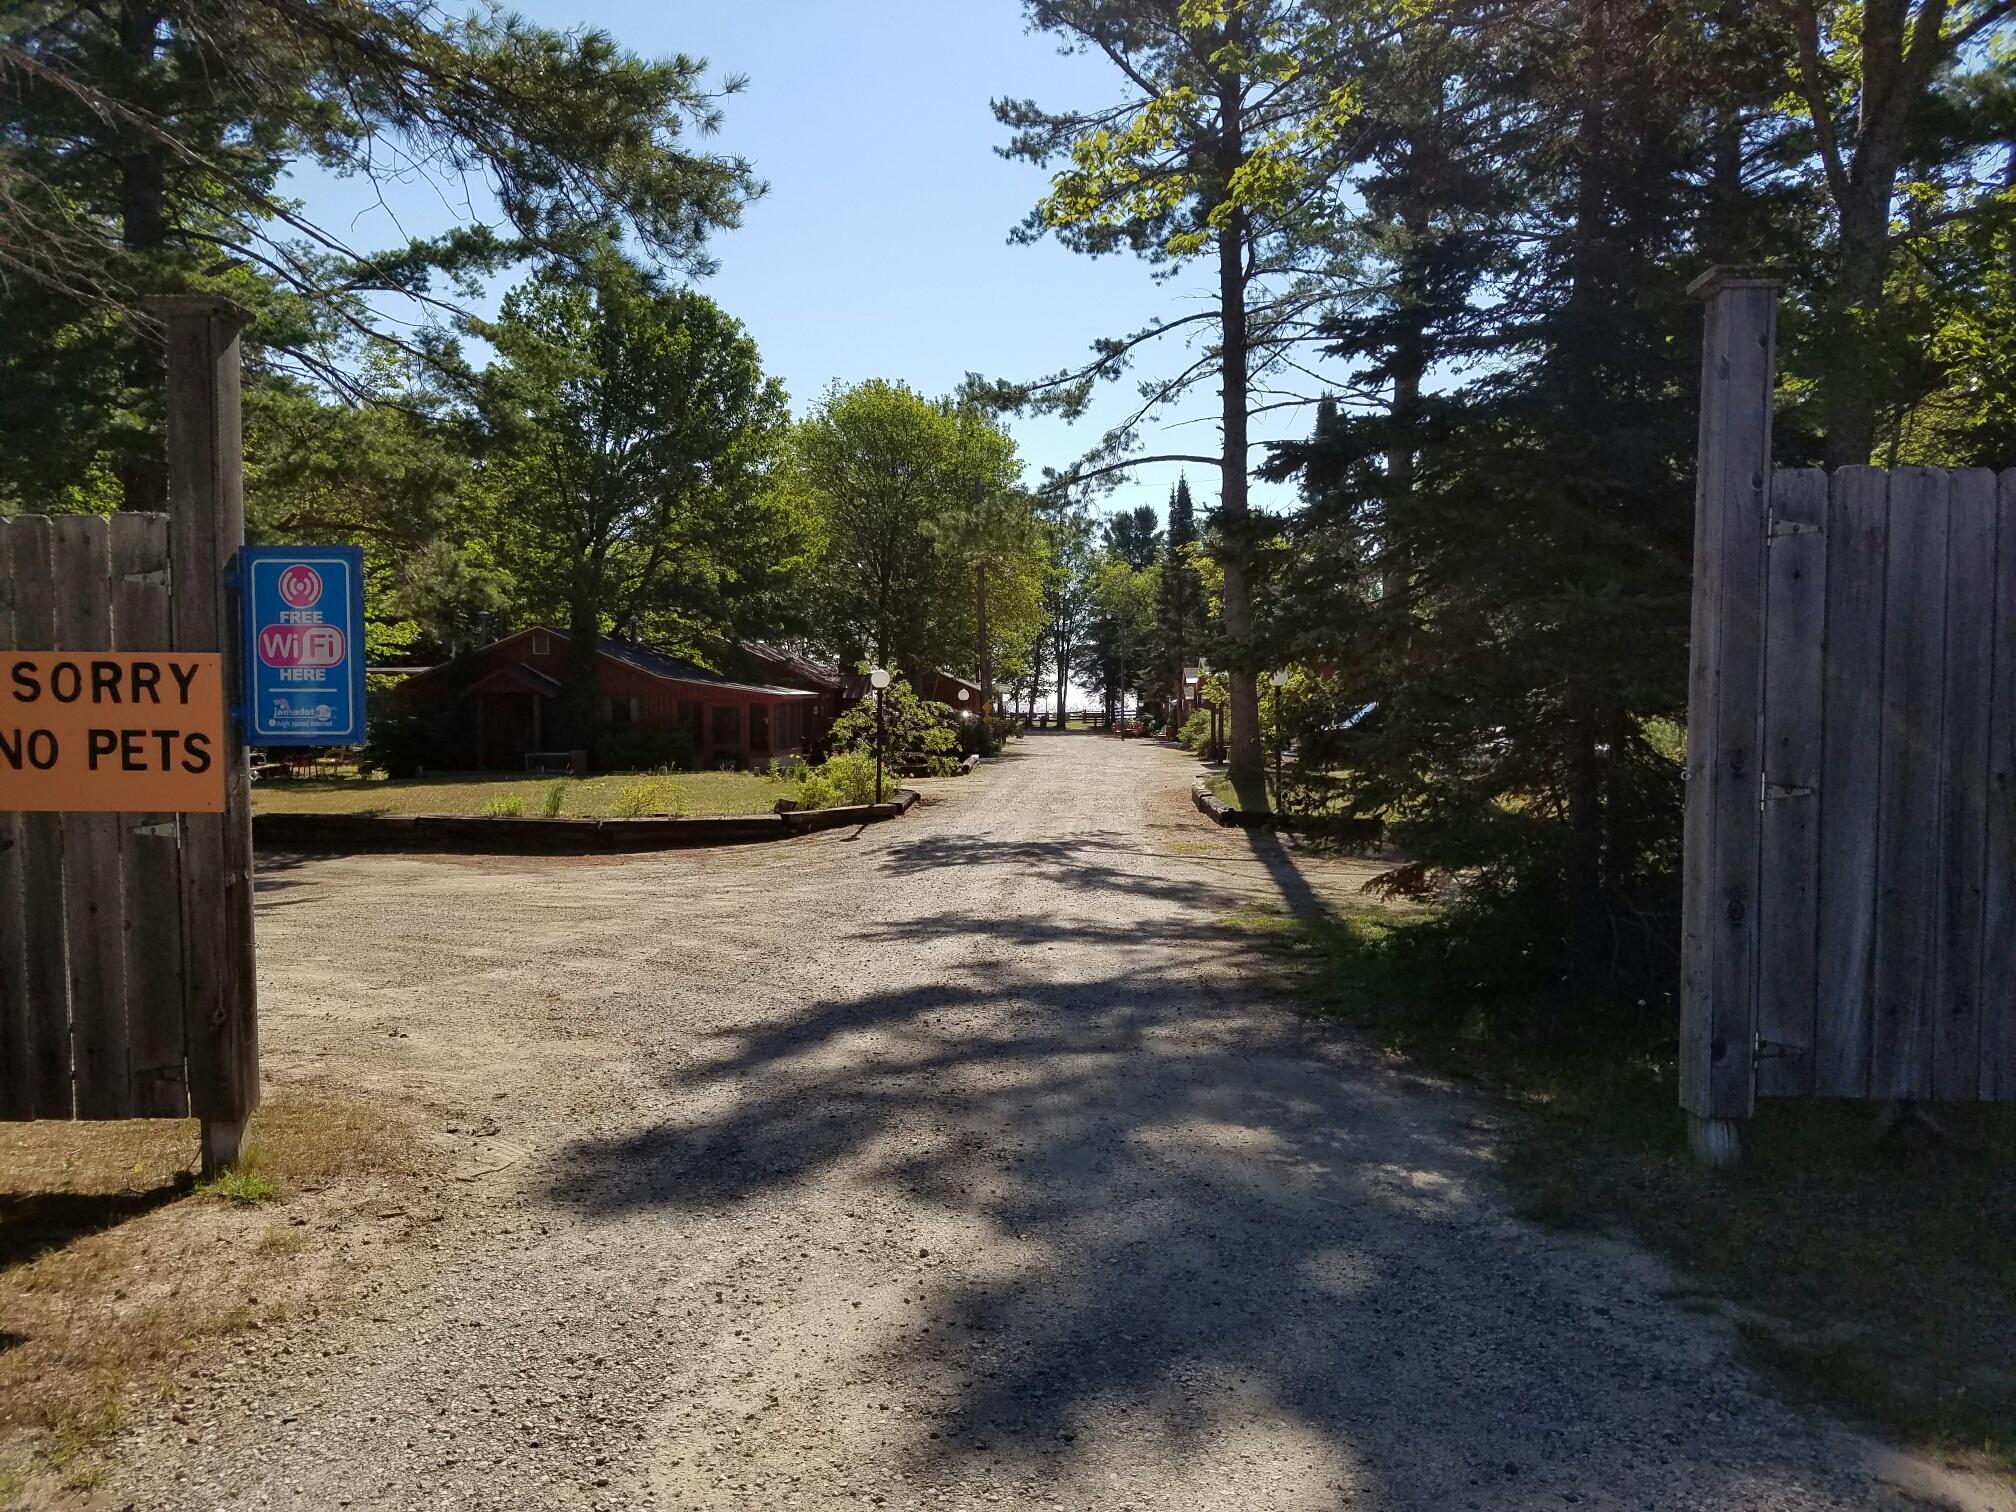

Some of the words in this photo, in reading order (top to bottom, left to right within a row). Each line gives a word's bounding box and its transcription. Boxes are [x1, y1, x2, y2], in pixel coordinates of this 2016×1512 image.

[280, 611, 323, 624] FREE
[262, 633, 334, 658] WiFi
[11, 661, 199, 704] SORRY
[280, 668, 326, 681] HERE
[0, 729, 59, 770] NO
[88, 729, 211, 773] PETS
